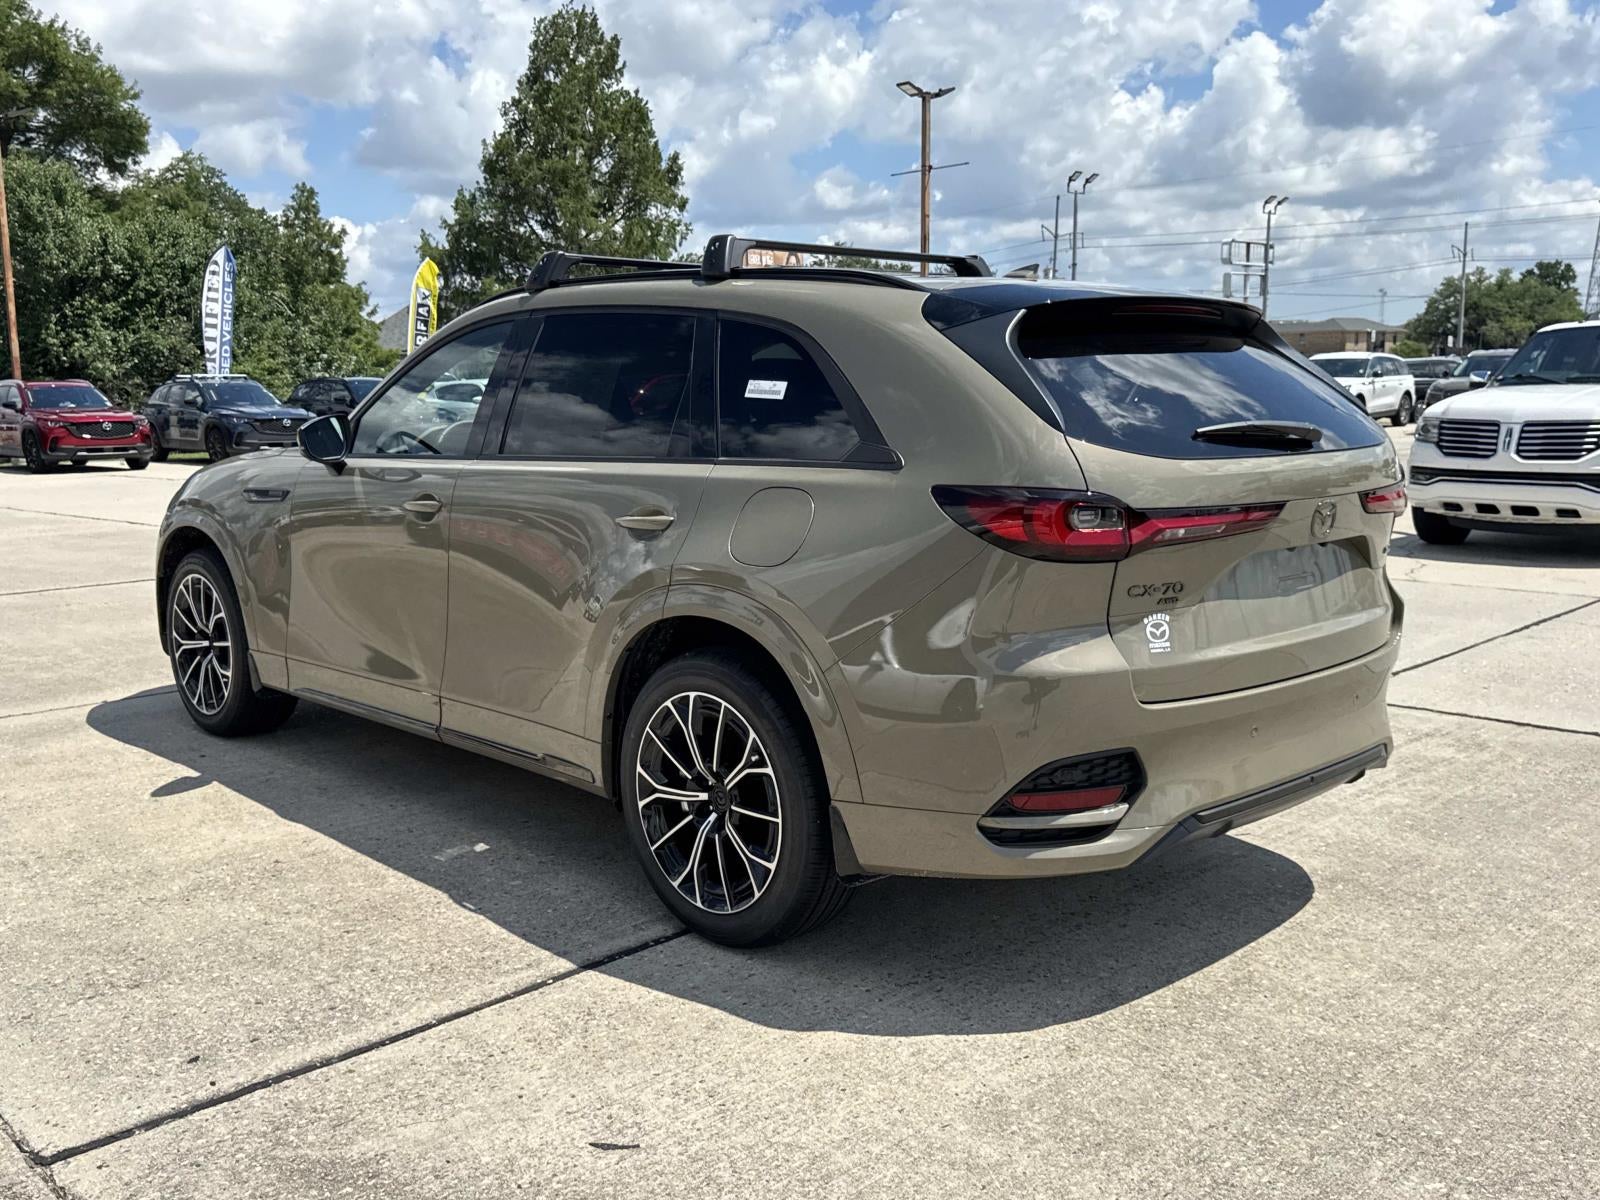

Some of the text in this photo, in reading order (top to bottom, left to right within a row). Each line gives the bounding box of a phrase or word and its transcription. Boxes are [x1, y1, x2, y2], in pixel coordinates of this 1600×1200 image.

[221, 261, 234, 374] SED VEHICLES
[416, 291, 430, 346] RFAX
[1127, 581, 1184, 598] CX-70
